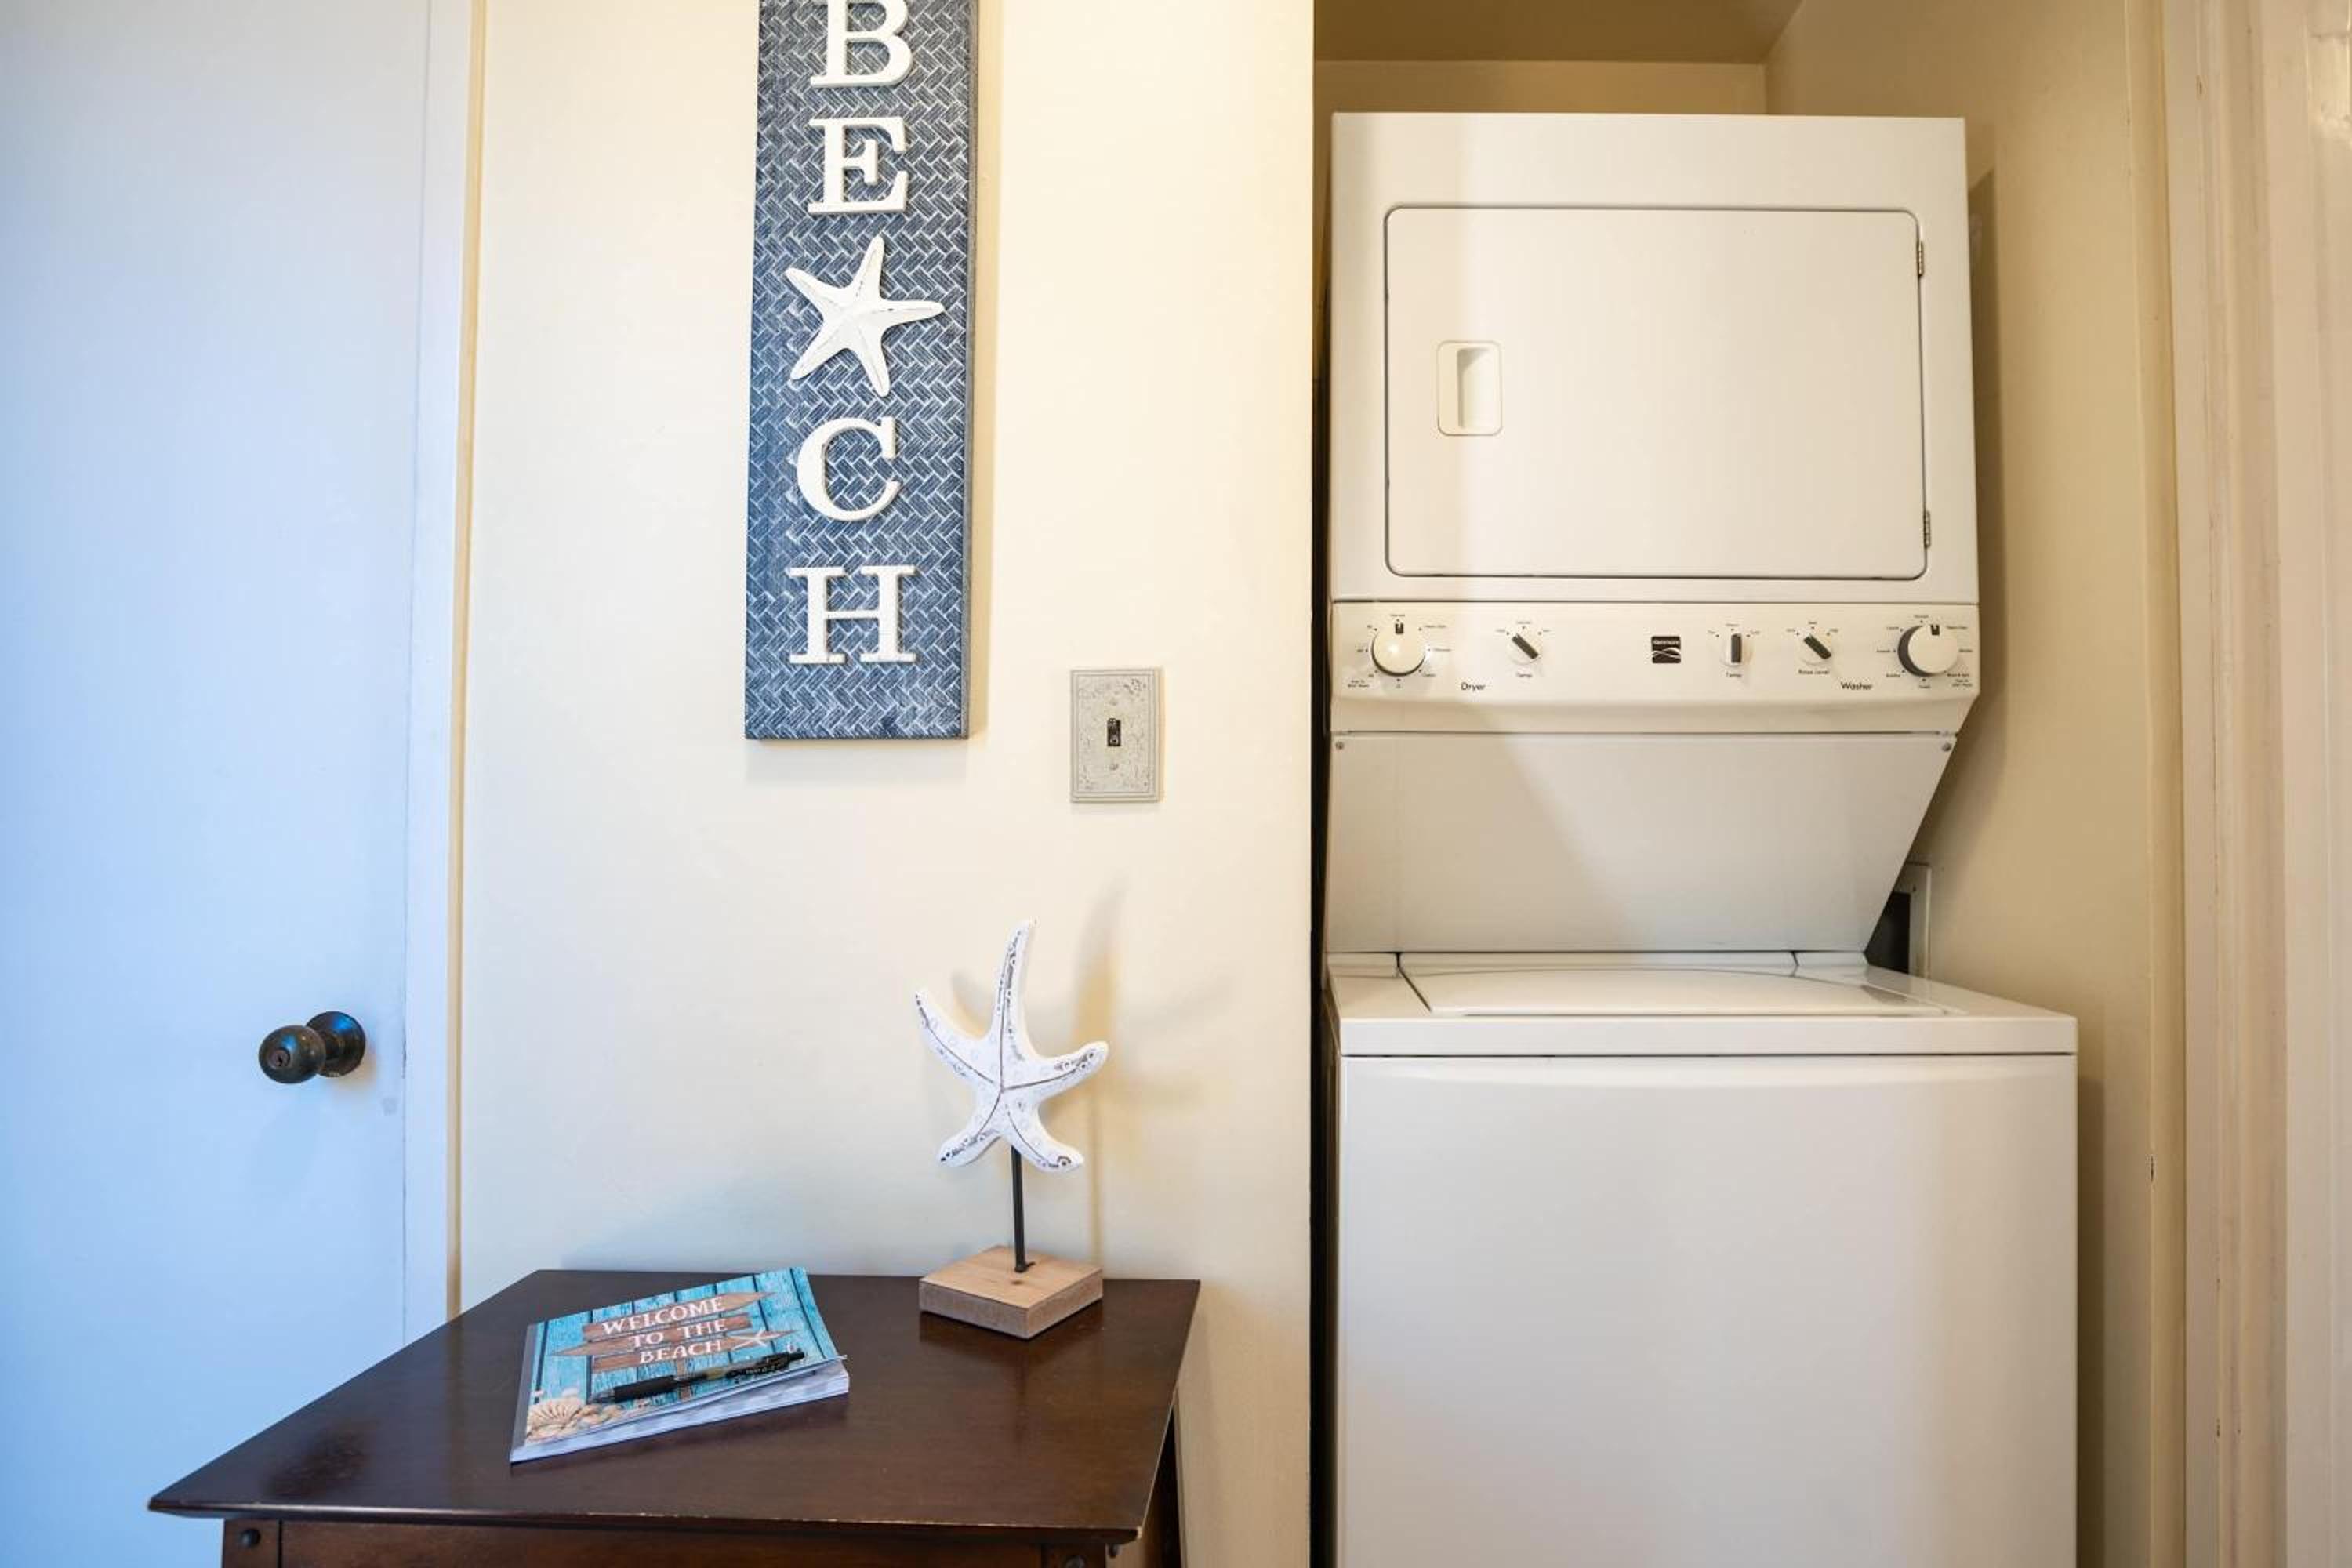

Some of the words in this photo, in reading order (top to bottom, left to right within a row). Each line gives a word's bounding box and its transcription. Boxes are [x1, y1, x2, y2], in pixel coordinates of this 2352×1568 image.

[1461, 681, 1486, 693] Dryer
[1840, 681, 1873, 691] Washer
[601, 1296, 726, 1334] WELCOME
[629, 1331, 664, 1348] TO
[677, 1319, 728, 1338] THE
[639, 1340, 722, 1363] BEACH
